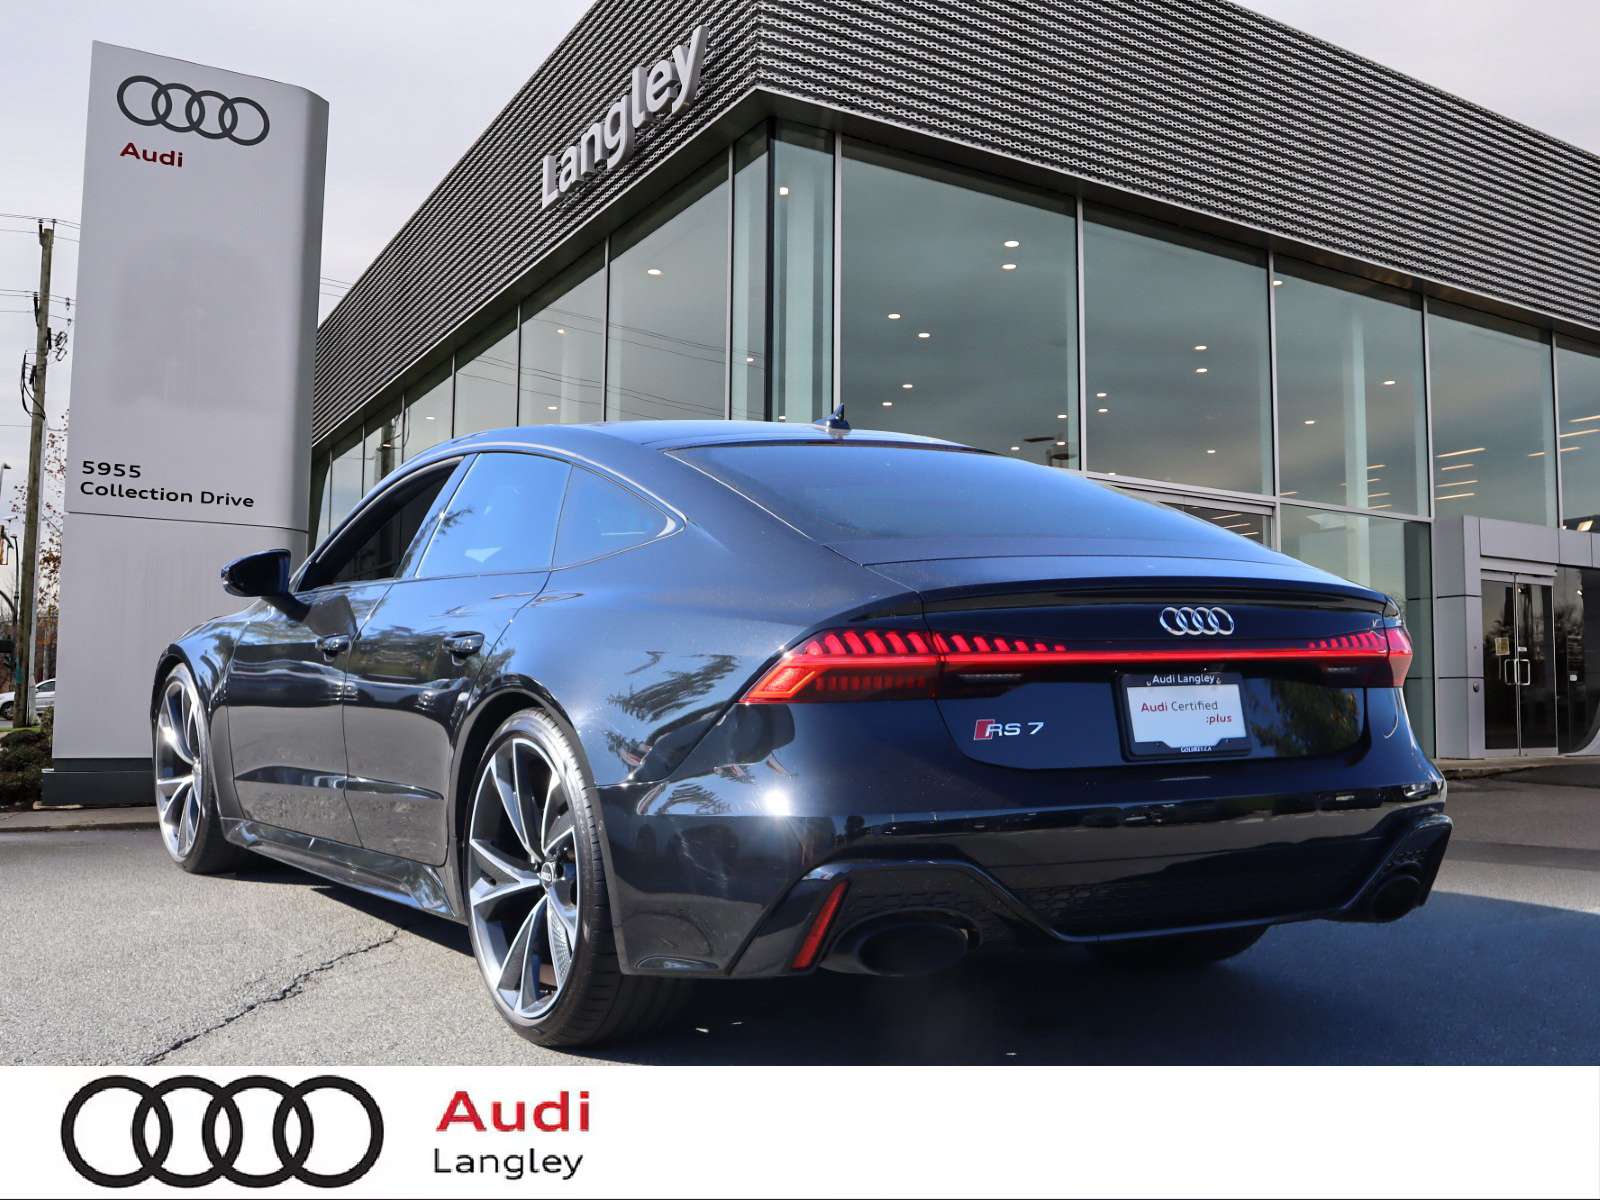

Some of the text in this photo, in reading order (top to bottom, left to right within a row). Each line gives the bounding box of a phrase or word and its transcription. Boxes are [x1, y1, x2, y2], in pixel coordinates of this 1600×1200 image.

[542, 24, 710, 209] Langley
[119, 142, 184, 168] Audi
[82, 460, 142, 478] 5955
[80, 481, 255, 508] Collection Drive
[1152, 673, 1215, 685] Audi Langley
[1141, 701, 1218, 712] Audi Certified
[1206, 714, 1232, 725] :plus
[984, 721, 1045, 737] RS 7
